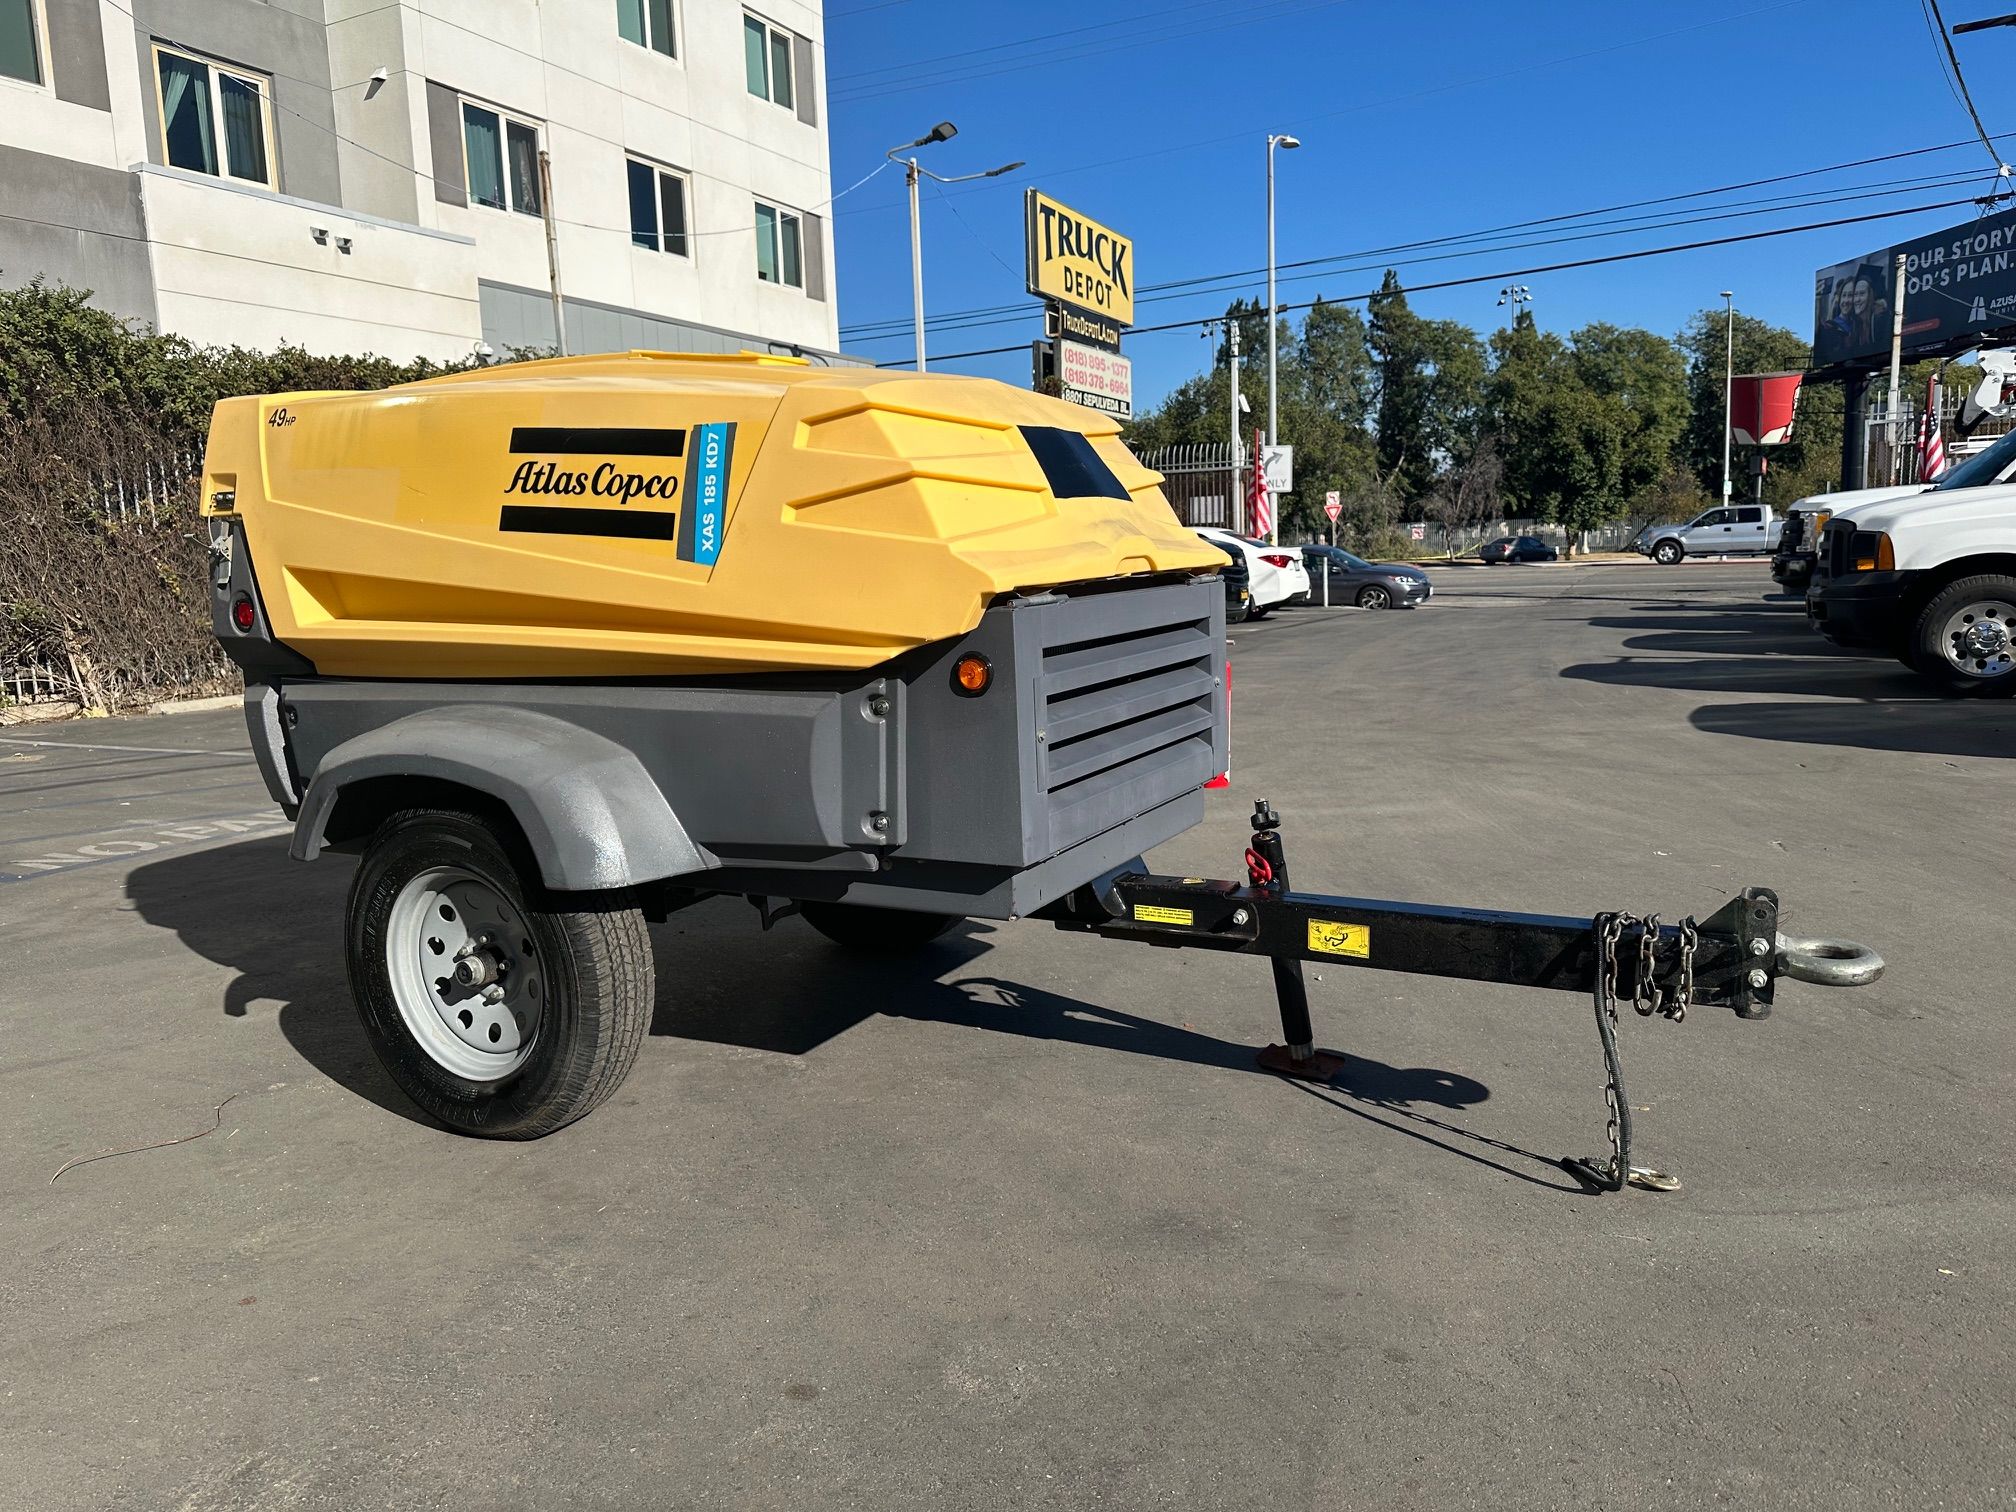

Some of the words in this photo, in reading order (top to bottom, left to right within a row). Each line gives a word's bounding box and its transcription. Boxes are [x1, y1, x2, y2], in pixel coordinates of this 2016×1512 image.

[1039, 202, 1130, 302] TRUCK
[1906, 246, 1945, 273] OUR
[1063, 265, 1113, 310] DEPOT
[1907, 268, 1950, 295] OD'S
[1956, 252, 2015, 282] PLAN.
[1064, 348, 1087, 367] (818)
[1064, 367, 1087, 386] (818)
[1083, 393, 1119, 412] SEPULVEDA
[706, 432, 720, 469] KD7
[503, 460, 589, 496] Atlas
[591, 462, 679, 505] Copco
[704, 474, 717, 506] 185
[1266, 479, 1287, 488] NLY
[701, 511, 716, 552] XAS
